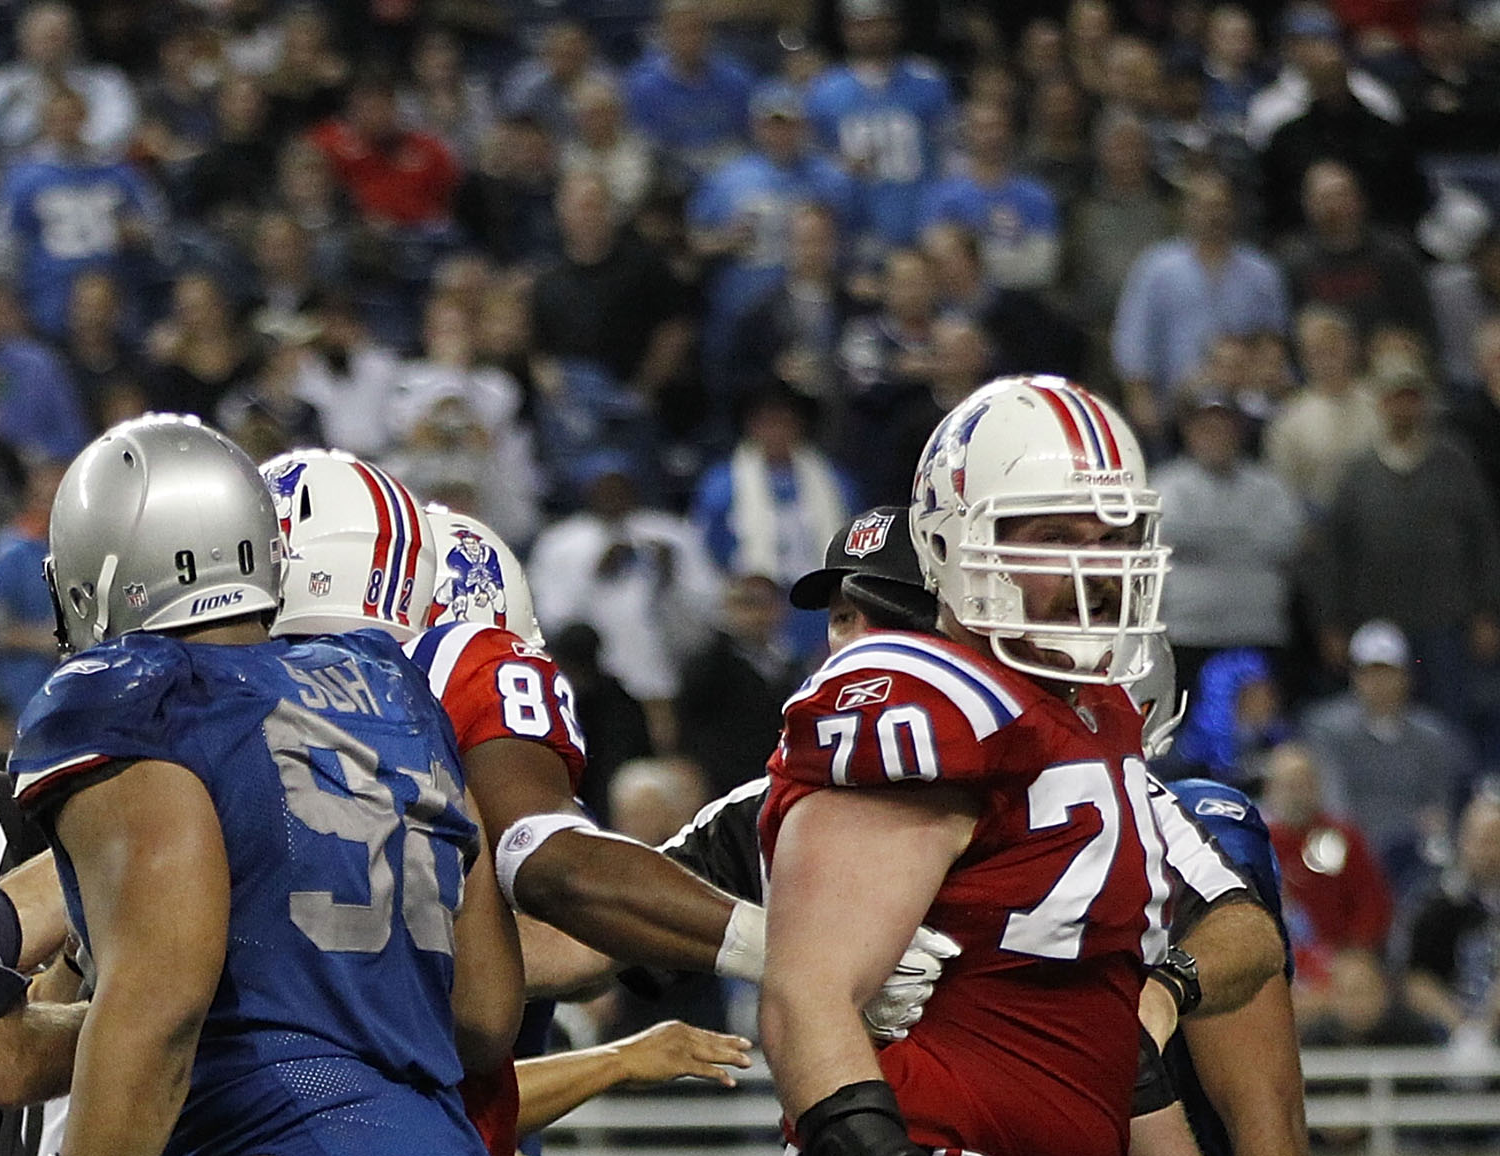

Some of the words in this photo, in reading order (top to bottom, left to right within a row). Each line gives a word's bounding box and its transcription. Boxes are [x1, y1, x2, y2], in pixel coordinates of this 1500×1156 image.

[847, 527, 884, 550] NFL
[189, 588, 245, 618] LIONS
[276, 654, 384, 718] SUH
[815, 704, 939, 787] 70
